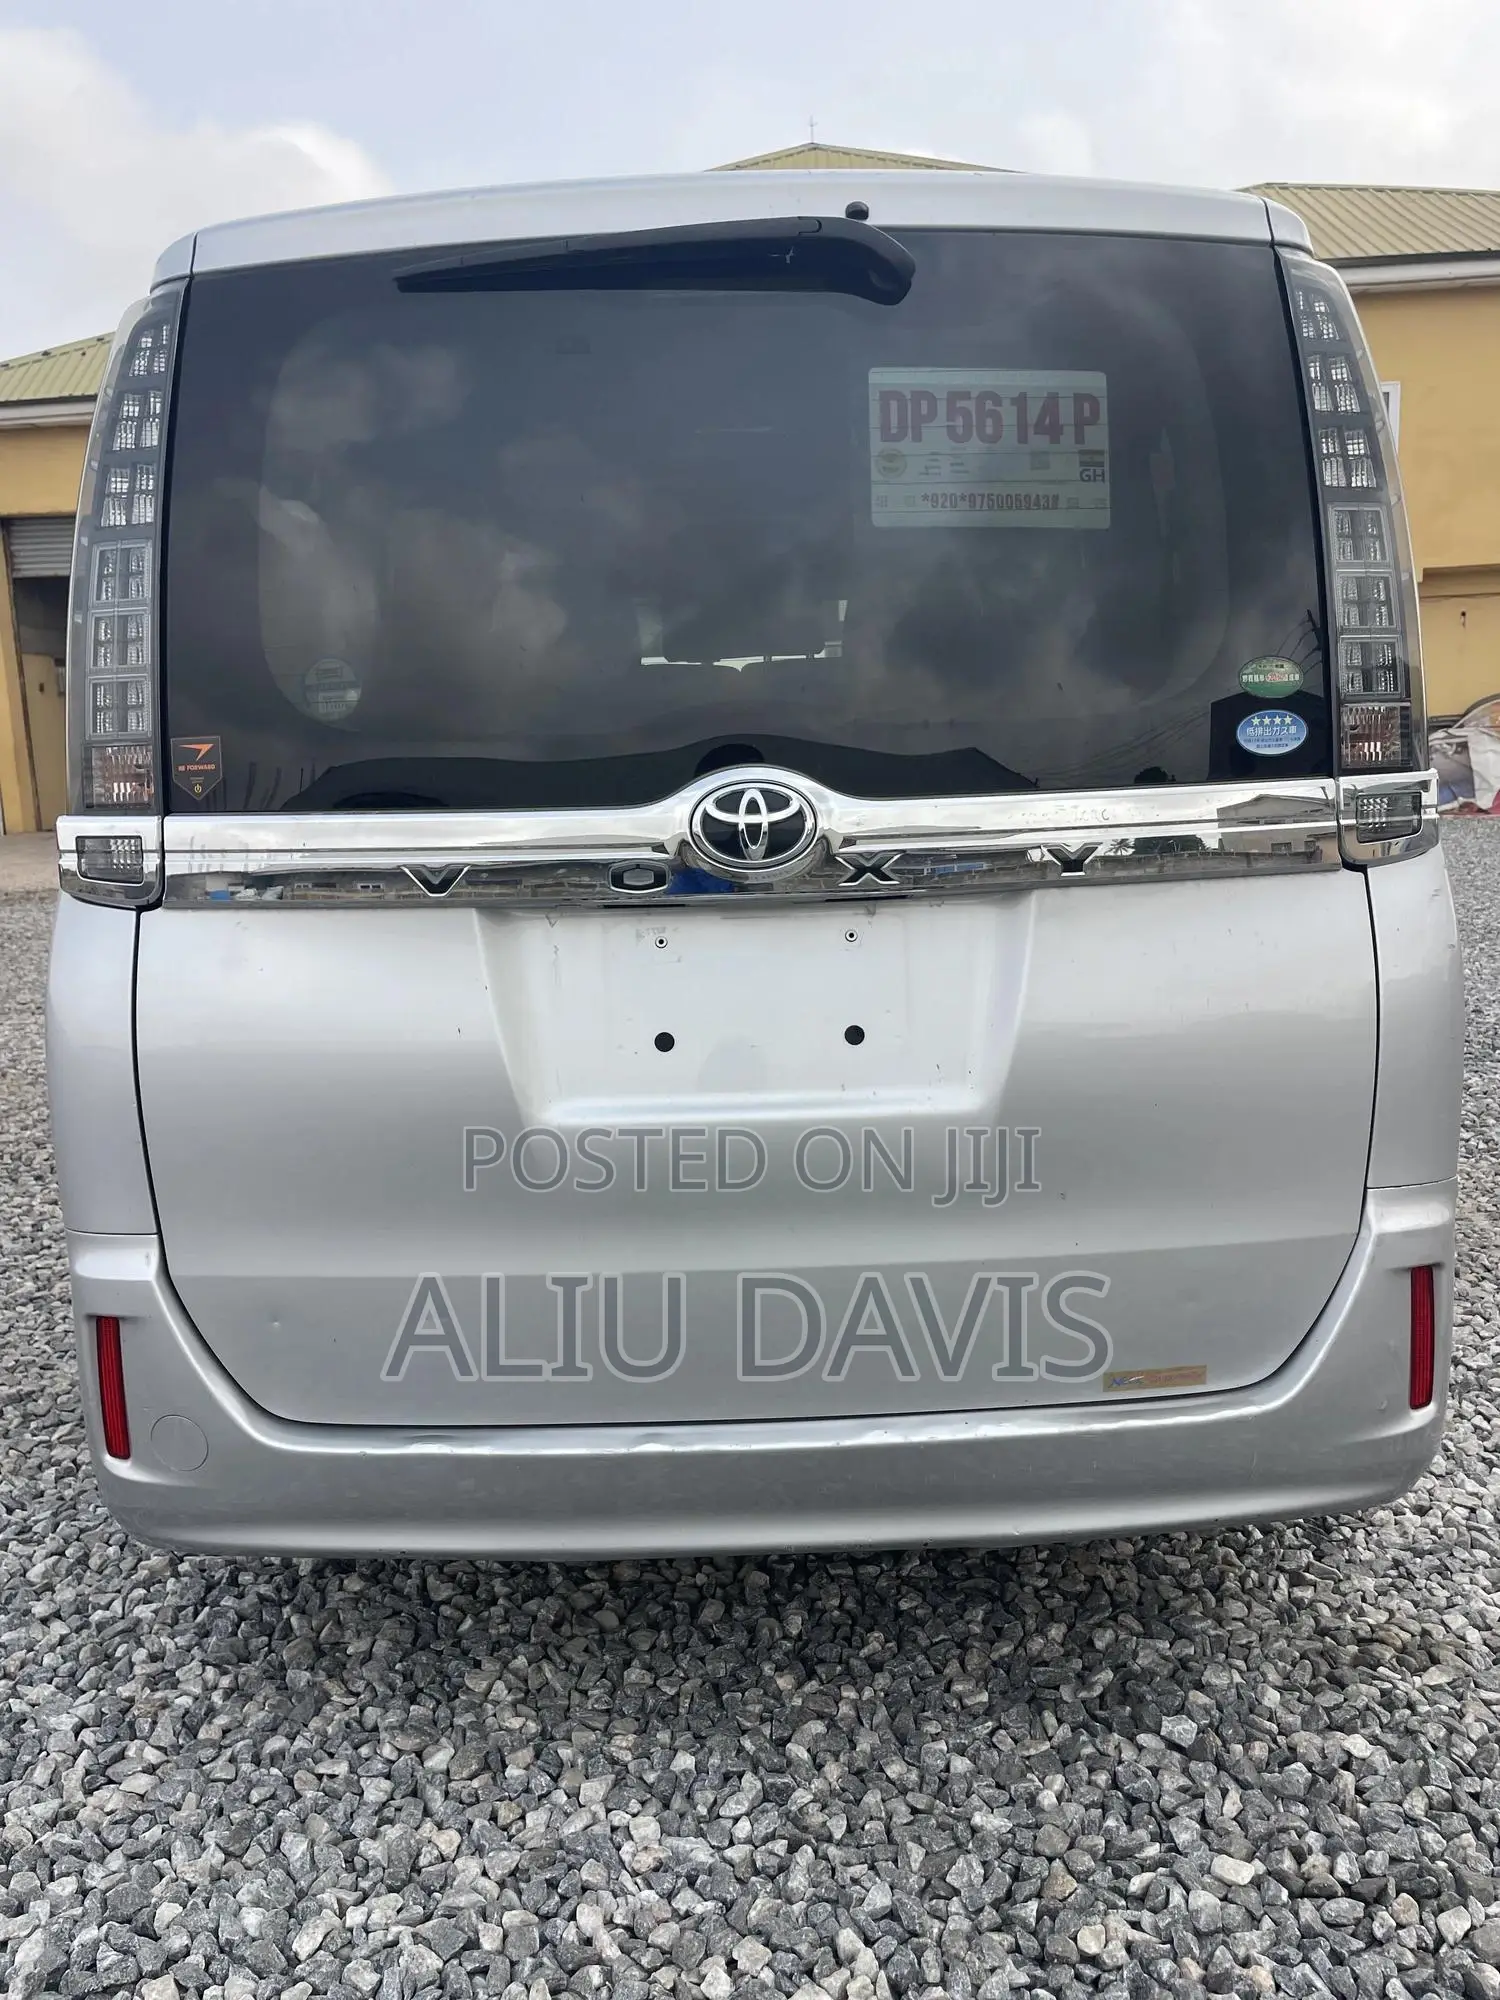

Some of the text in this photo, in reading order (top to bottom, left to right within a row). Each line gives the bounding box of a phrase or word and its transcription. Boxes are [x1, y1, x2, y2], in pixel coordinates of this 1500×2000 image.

[878, 389, 939, 443] DP
[1072, 392, 1101, 445] P
[1078, 468, 1107, 484] GH
